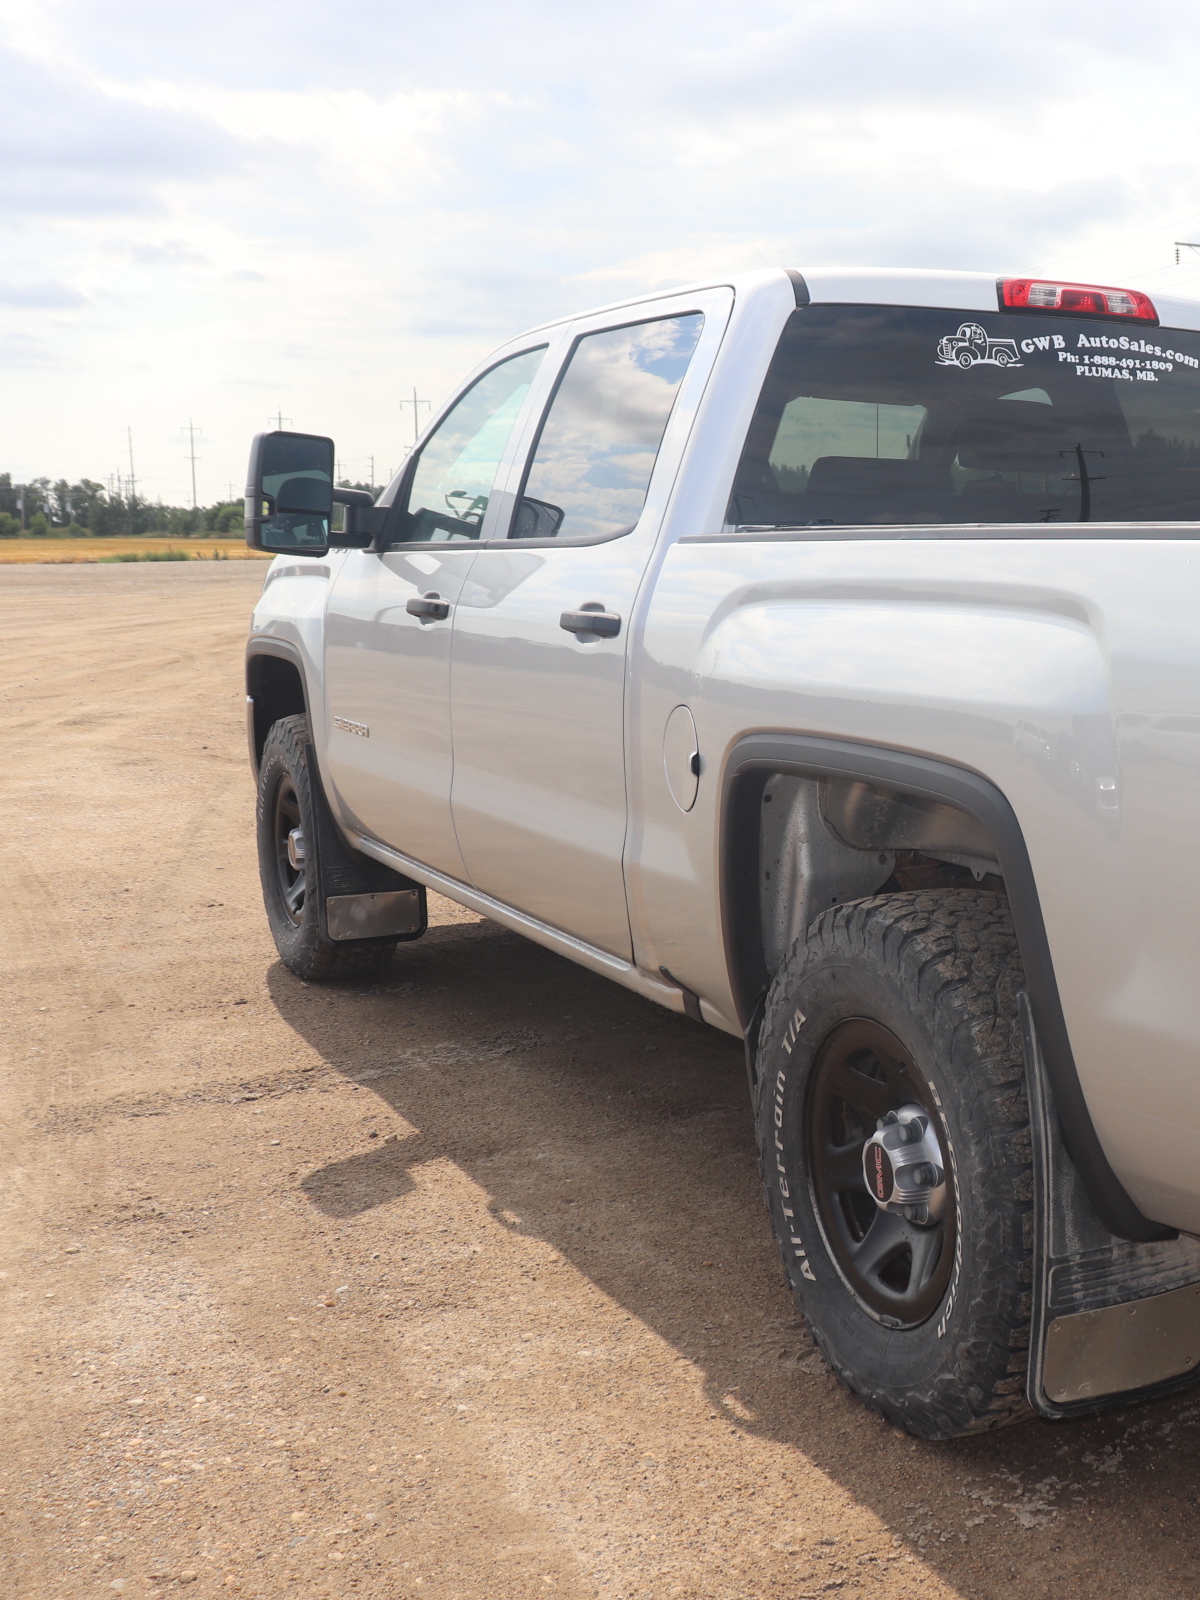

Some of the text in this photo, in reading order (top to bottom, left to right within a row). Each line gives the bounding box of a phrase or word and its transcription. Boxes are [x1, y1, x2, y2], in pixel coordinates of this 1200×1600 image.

[1021, 333, 1199, 369] GWB AutoSales.com
[1057, 351, 1173, 372] Ph: 1-888-491-1809
[1075, 365, 1158, 381] PLUMAS, MB.
[333, 715, 370, 738] SIERRA
[774, 1008, 817, 1281] All-Terrain T/A
[875, 1146, 884, 1198] GMC
